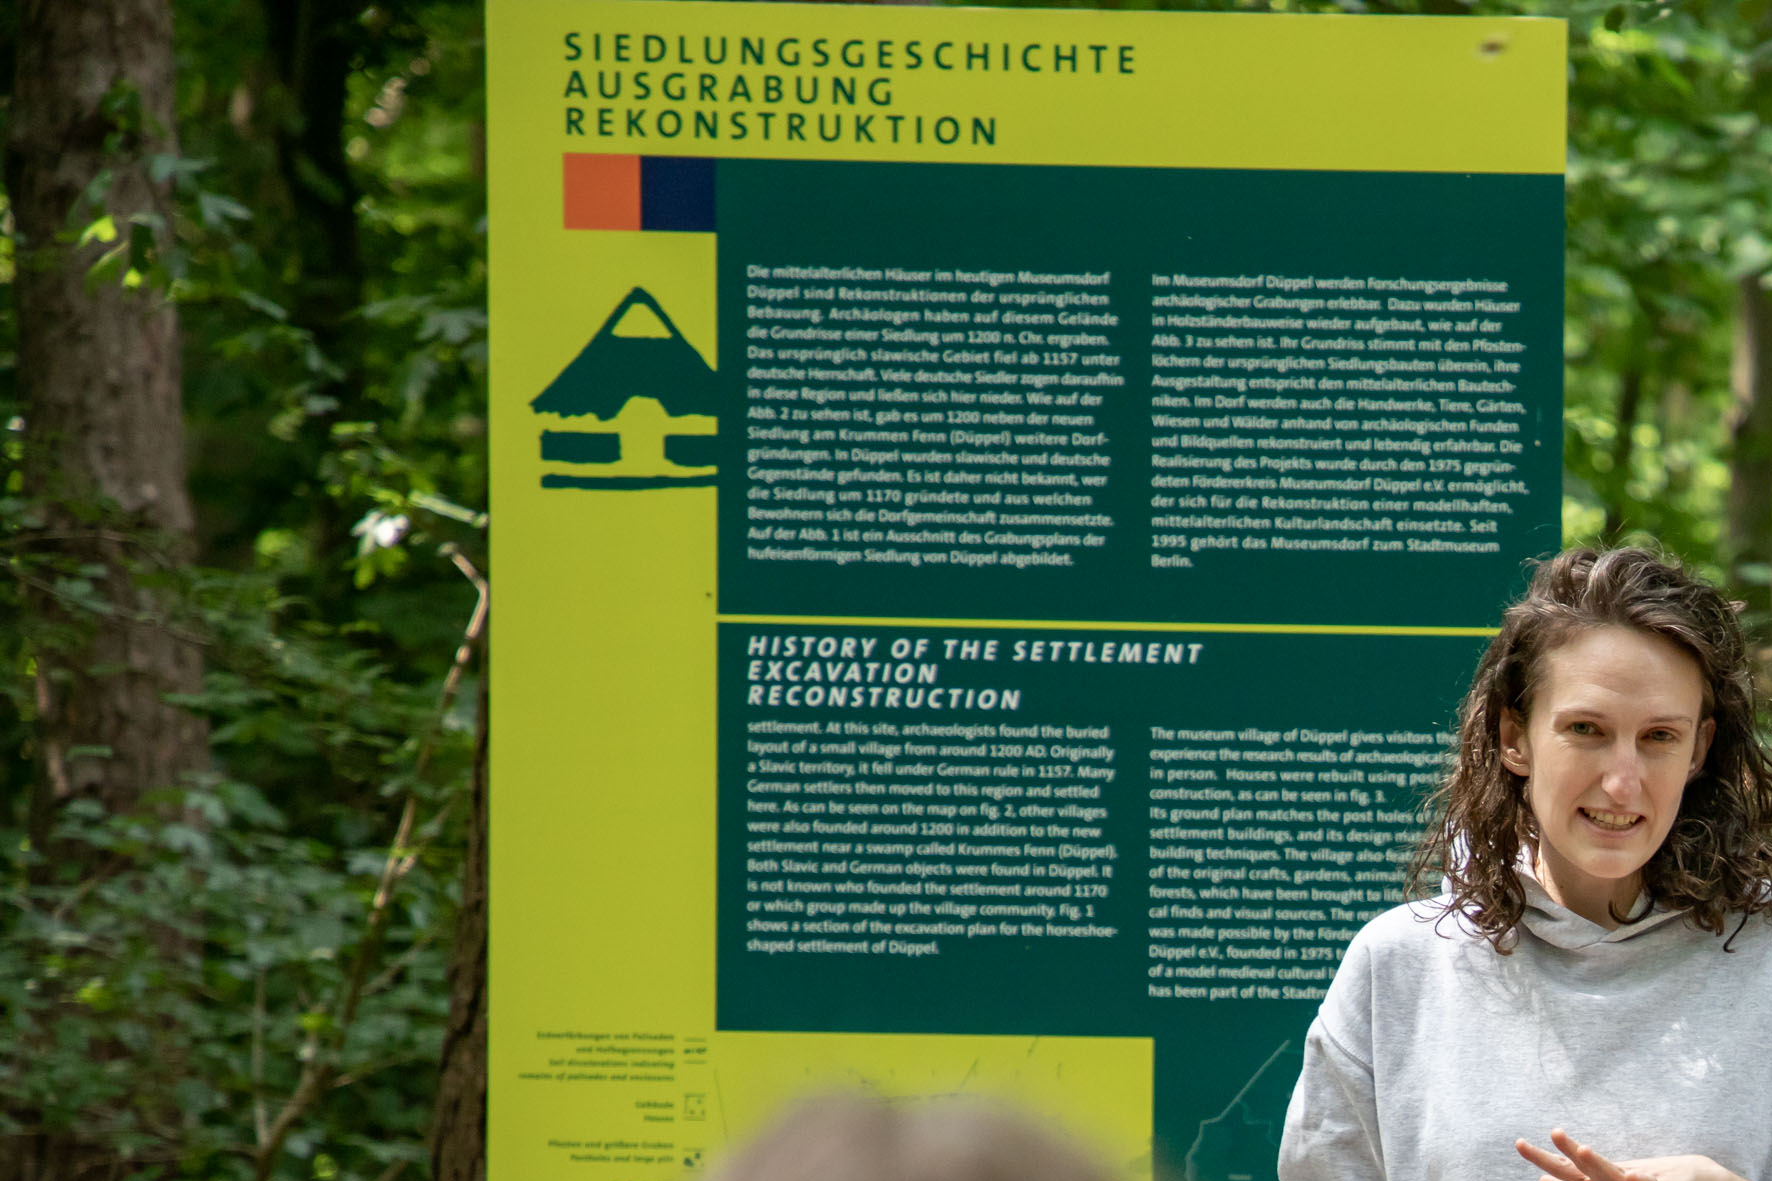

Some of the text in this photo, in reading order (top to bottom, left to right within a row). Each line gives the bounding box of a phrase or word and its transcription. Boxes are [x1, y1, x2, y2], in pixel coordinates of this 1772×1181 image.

[563, 31, 1135, 76] SIEDLUNGSGESCHICHTE
[563, 68, 893, 108] AUSGRABUNG
[564, 106, 997, 148] REKONSTRUKTION
[746, 264, 1110, 287] Die mittelalterlichen Häuser im heutigen Museumsdorf
[1151, 272, 1508, 296] Im Museumsdorf Düppel werden Forschungsergebnisse
[746, 284, 1110, 309] Düppel sind Rekonstruktionen der ursprünglichen
[828, 307, 921, 325] Archäologen
[923, 308, 970, 323] haben
[972, 309, 999, 323] auf
[1000, 310, 1055, 324] diesem
[1056, 311, 1119, 326] Gelände
[746, 344, 1120, 366] Das ursprünglich slawische Gebiet fiel ab 1157 unter
[746, 425, 1108, 447] Siedlung am Krummen Fenn (Düppel) weitere Dorf-
[1150, 474, 1190, 488] deten
[1191, 474, 1278, 489] Fördererkreis
[1278, 475, 1372, 491] Museumsdorf
[1372, 477, 1422, 494] Düppel
[1150, 494, 1175, 507] der
[1177, 494, 1208, 507] sich
[1209, 494, 1232, 508] für
[1234, 495, 1259, 509] die
[1260, 495, 1370, 511] Rekonstruktion
[1371, 500, 1410, 511] einer
[747, 505, 824, 521] Bewohnern
[825, 508, 853, 521] sich
[853, 508, 876, 522] die
[877, 508, 997, 528] Dorfgemeinschaft
[1150, 513, 1272, 529] mittelalterlichen
[1273, 514, 1393, 531] Kulturlandschaft
[1468, 518, 1498, 533] Seit
[1151, 533, 1500, 553] 1995 gehört das Museumsdorf zum Stadtmuseum
[747, 635, 1204, 665] HISTORY OF THE SETTLEMENT
[747, 659, 938, 685] EXCAVATION
[747, 684, 1021, 711] RECONSTRUCTION
[824, 721, 842, 734] At
[843, 721, 870, 734] this
[901, 722, 997, 740] archaeologists
[998, 723, 1040, 737] found
[1039, 724, 1064, 738] the
[1065, 725, 1110, 739] buried
[1150, 726, 1176, 740] The
[1176, 729, 1236, 741] museum
[1236, 727, 1282, 745] village
[1281, 727, 1299, 742] of
[1299, 728, 1348, 745] Düppel
[1348, 731, 1384, 747] gives
[1385, 730, 1434, 744] visitors
[746, 739, 789, 756] layout
[790, 739, 808, 753] of
[807, 742, 818, 753] a
[819, 740, 857, 754] small
[857, 741, 902, 758] village
[903, 741, 938, 756] from
[938, 743, 988, 756] around
[989, 743, 1024, 758] 1200
[1049, 744, 1115, 762] Originally
[1149, 767, 1165, 779] in
[1225, 767, 1278, 781] Houses
[1278, 770, 1315, 781] were
[1317, 768, 1365, 783] rebuilt
[1367, 770, 1407, 787] using
[746, 778, 1100, 801] German settlers then moved to this region and settled
[746, 839, 819, 853] settlement
[821, 842, 852, 853] near
[854, 842, 864, 853] a
[865, 843, 915, 857] swamp
[915, 841, 956, 855] called
[957, 842, 1022, 856] Krummes
[1023, 843, 1056, 857] Fenn
[1148, 864, 1165, 878] of
[1165, 865, 1191, 879] the
[1192, 866, 1247, 884] original
[1147, 904, 1169, 918] cal
[1169, 904, 1204, 918] finds
[1205, 905, 1233, 919] and
[1232, 906, 1274, 920] visual
[1329, 907, 1355, 921] The
[1147, 943, 1197, 960] Düppel
[1225, 944, 1282, 959] founded
[1282, 948, 1298, 958] in
[1299, 946, 1334, 960] 1975
